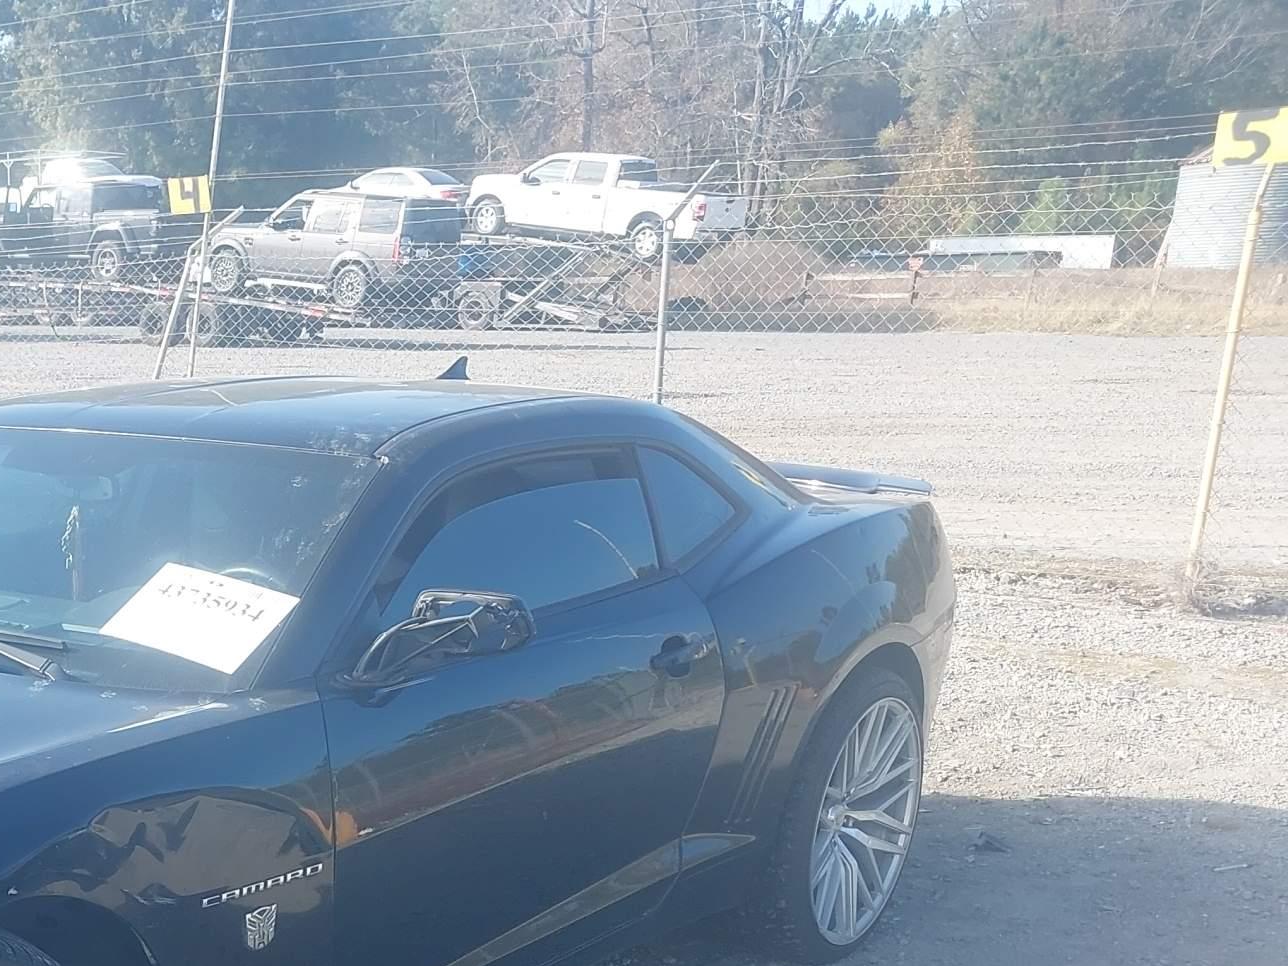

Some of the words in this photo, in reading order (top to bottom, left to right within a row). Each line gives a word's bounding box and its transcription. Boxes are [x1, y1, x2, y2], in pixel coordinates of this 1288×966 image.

[1222, 107, 1280, 166] 5
[179, 177, 200, 214] 4
[202, 863, 323, 908] CAMARO
